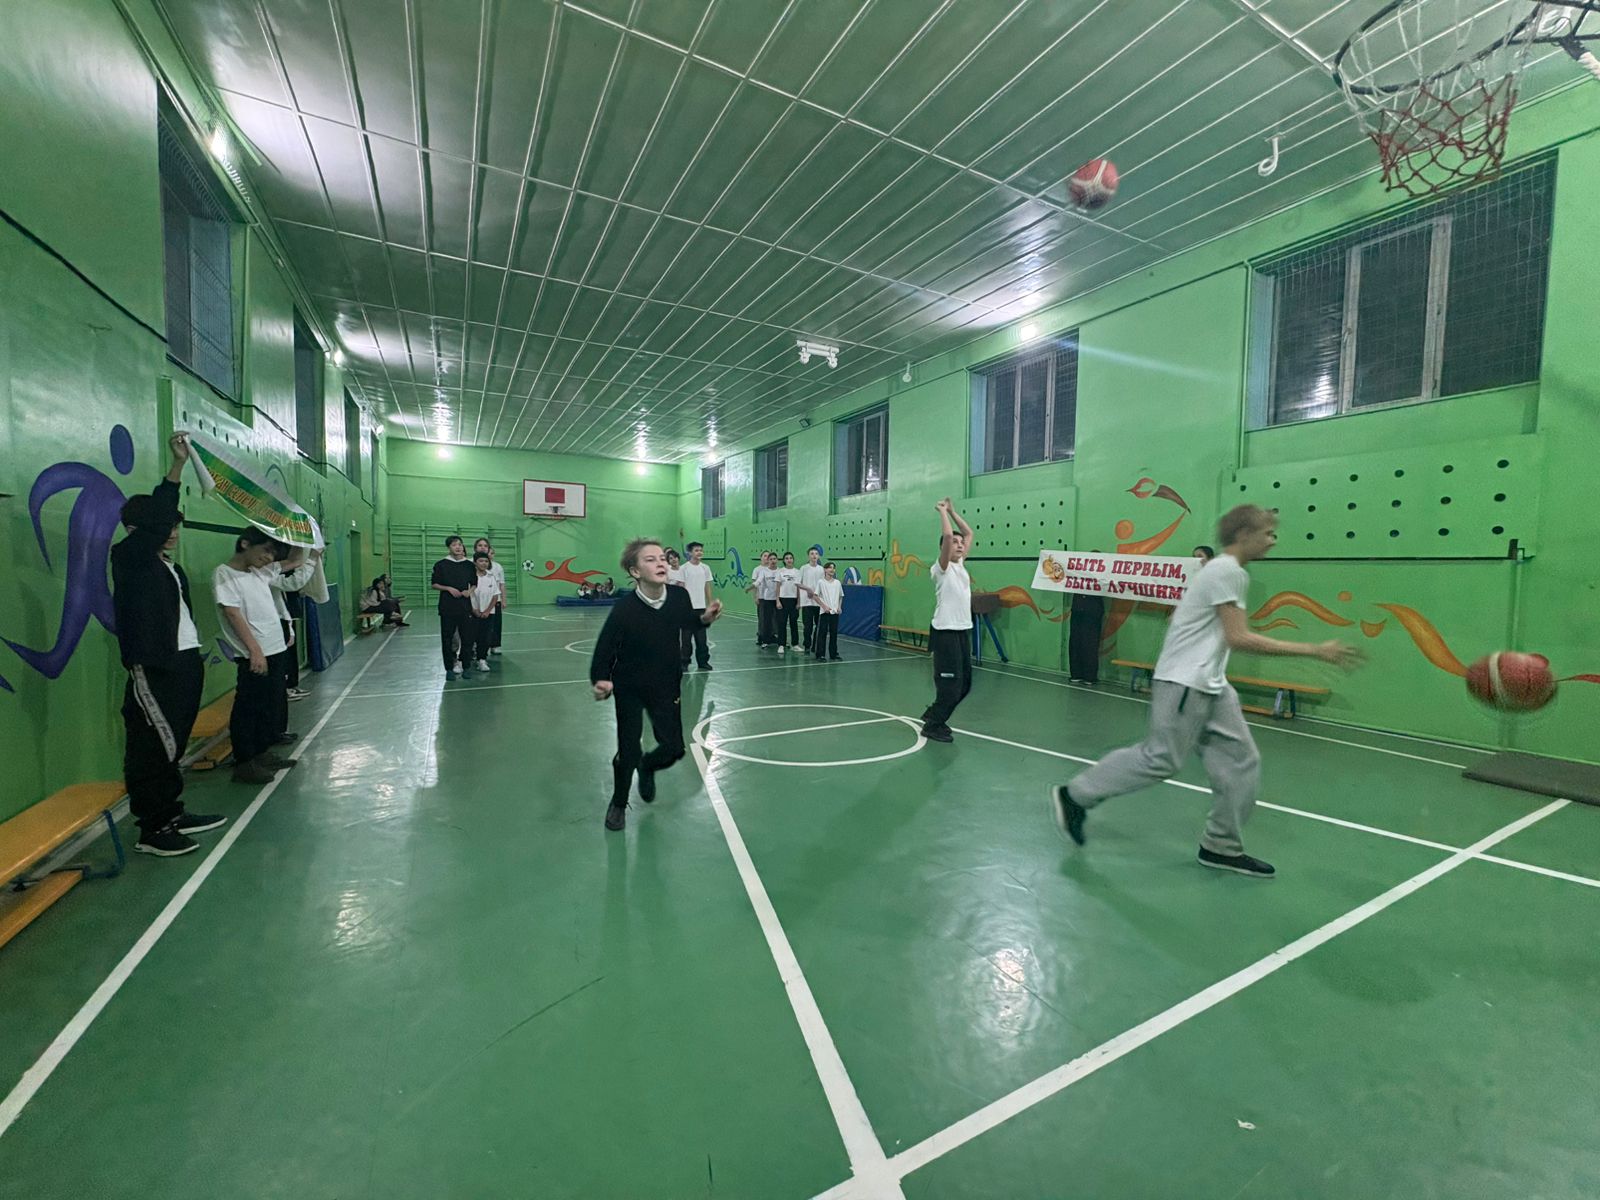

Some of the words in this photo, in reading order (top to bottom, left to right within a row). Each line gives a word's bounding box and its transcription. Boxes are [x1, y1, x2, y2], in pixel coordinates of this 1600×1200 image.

[1067, 557, 1106, 573] БЫТЬ
[1111, 560, 1187, 583] ПЕРВЫМ,
[1065, 575, 1102, 592] БЫТЬ
